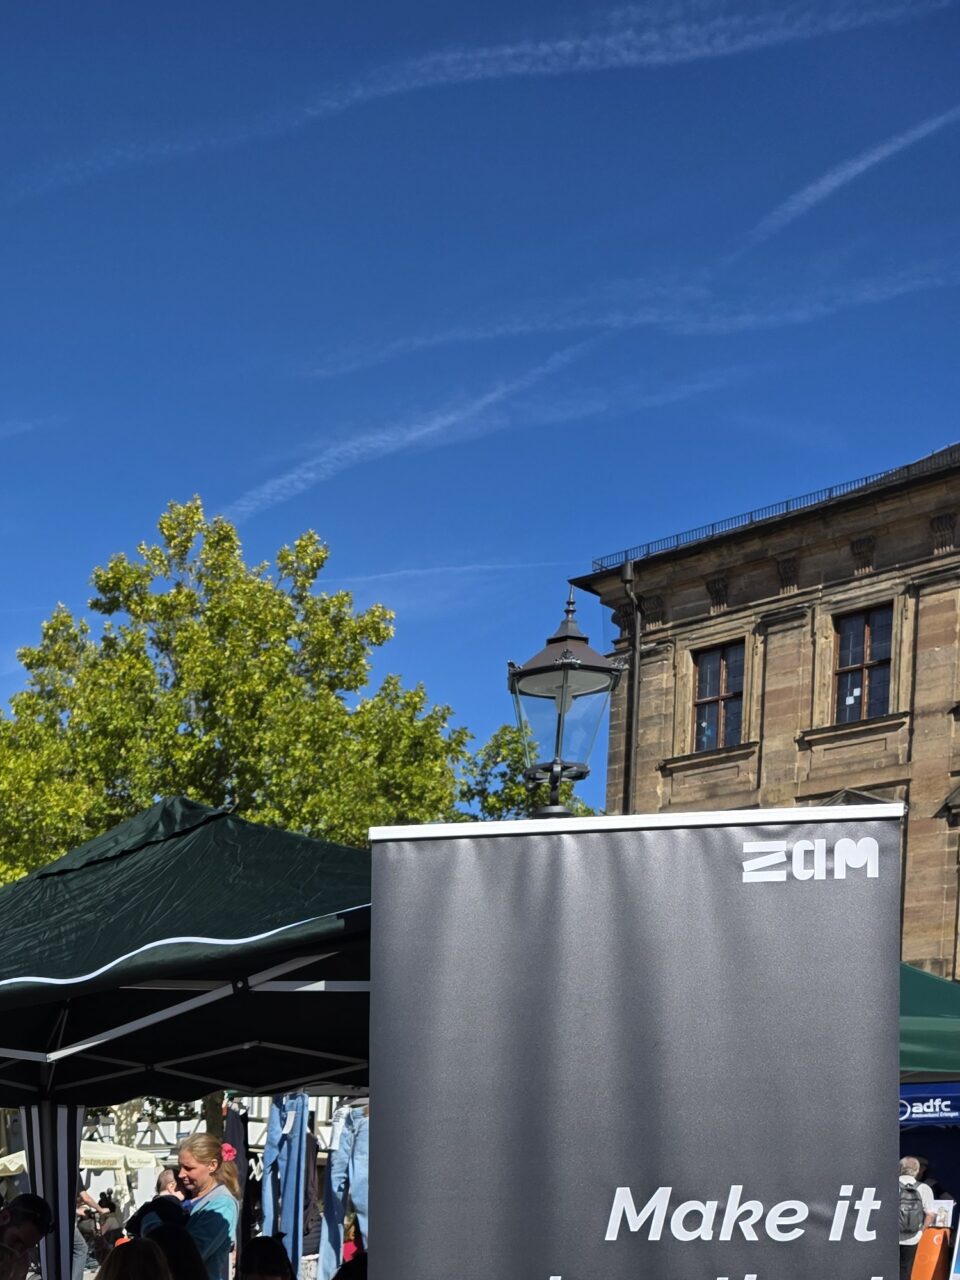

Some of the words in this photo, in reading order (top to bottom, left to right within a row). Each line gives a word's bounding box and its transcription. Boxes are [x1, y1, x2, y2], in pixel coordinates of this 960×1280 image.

[912, 1098, 951, 1113] adfc
[605, 1184, 809, 1242] Make
[828, 1184, 882, 1242] it
